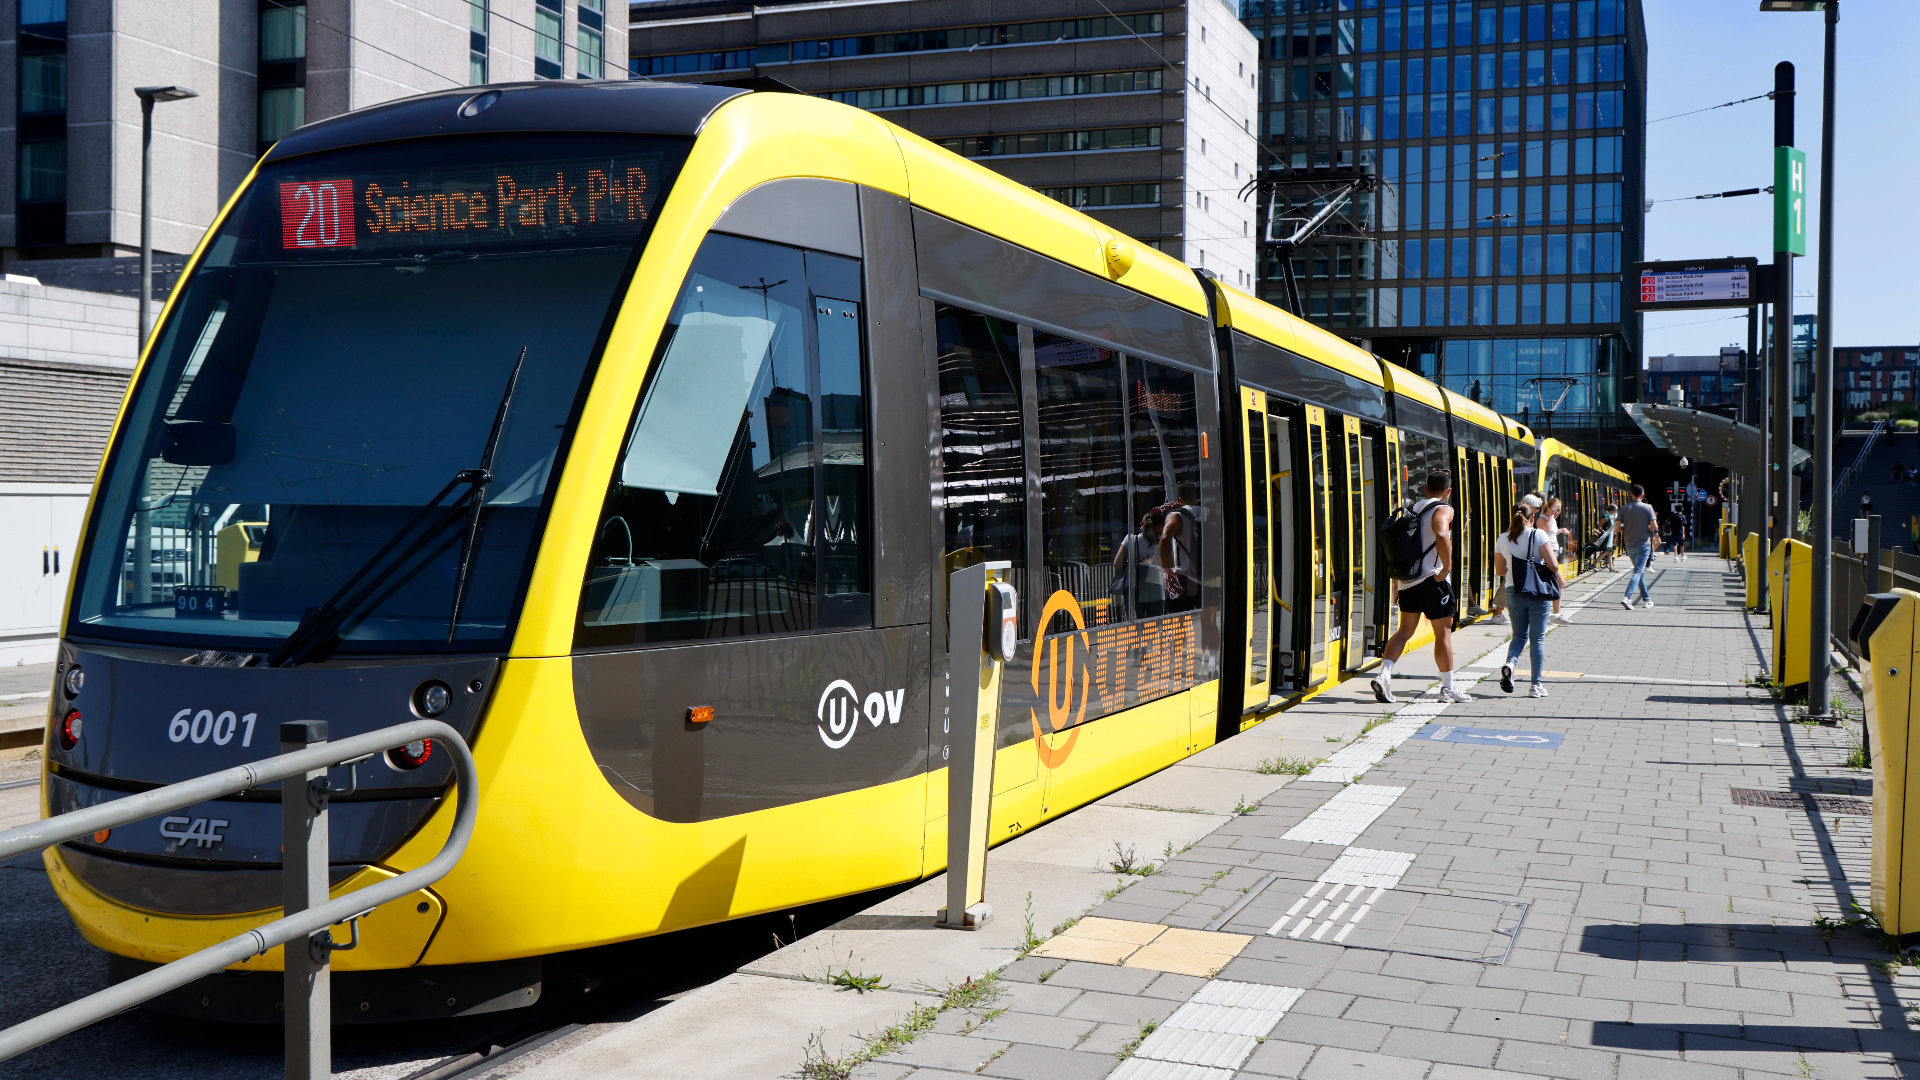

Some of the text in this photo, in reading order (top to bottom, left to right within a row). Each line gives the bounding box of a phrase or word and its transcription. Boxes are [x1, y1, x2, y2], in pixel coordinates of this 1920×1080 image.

[1792, 160, 1803, 193] H
[294, 167, 648, 246] 20 Science Park P+R
[1793, 198, 1802, 234] 1
[1096, 597, 1196, 714] tram
[168, 708, 258, 747] 6001
[863, 688, 905, 728] OV
[160, 816, 229, 848] CAF
